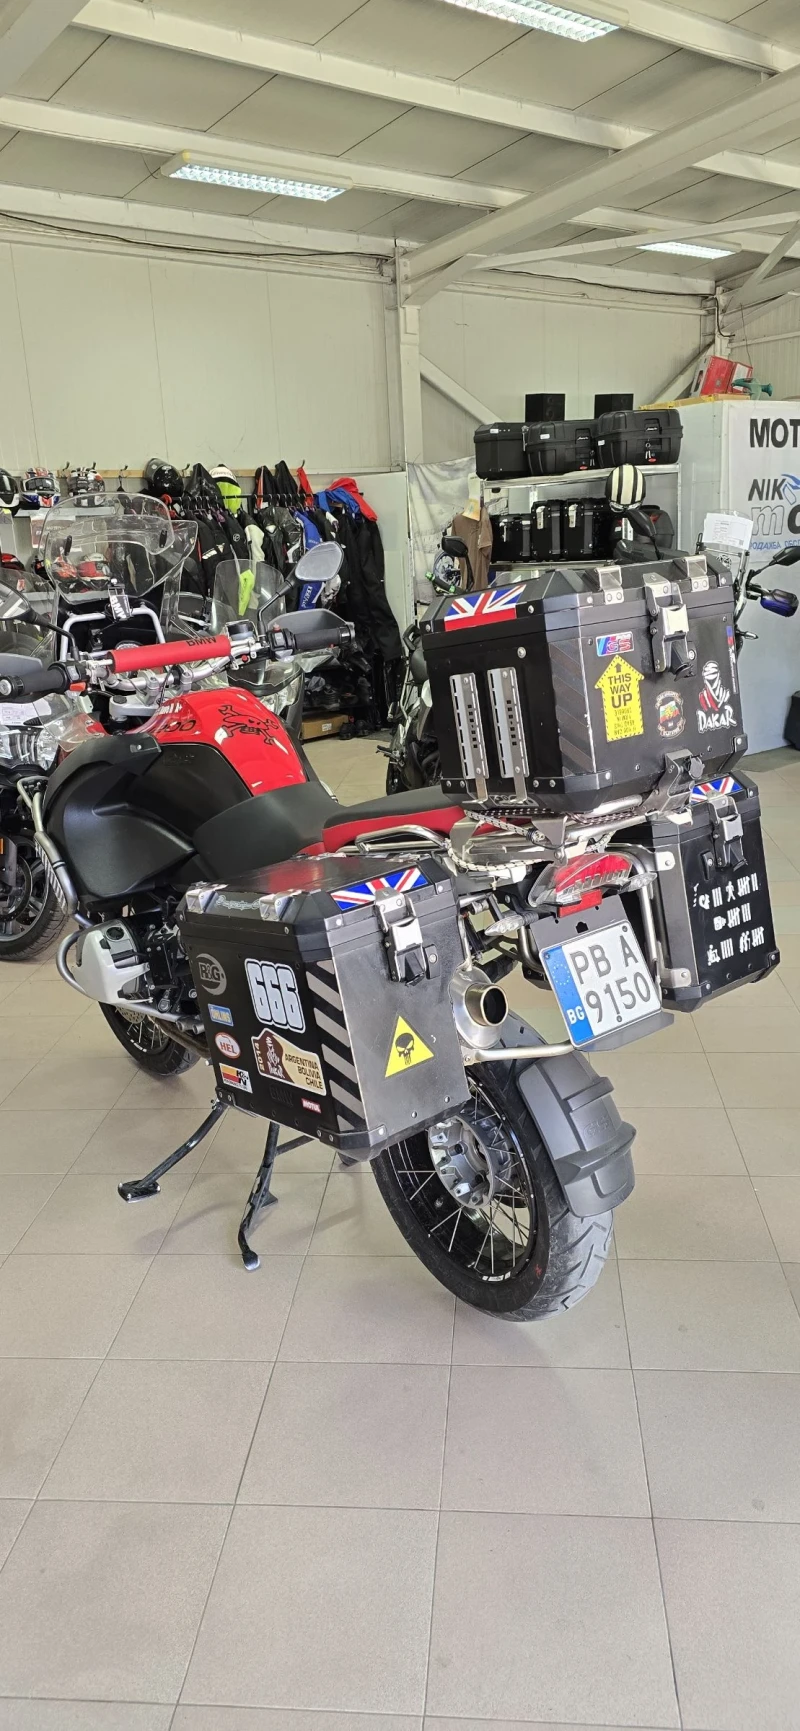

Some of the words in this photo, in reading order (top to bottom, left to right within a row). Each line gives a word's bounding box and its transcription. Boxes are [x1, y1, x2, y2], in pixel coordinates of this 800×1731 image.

[608, 673, 632, 686] THIS
[610, 683, 632, 695] WAY
[611, 693, 632, 709] UP
[697, 705, 737, 732] DAKAR
[569, 944, 611, 984] PB
[620, 935, 638, 967] A
[200, 963, 221, 980] R&G
[245, 959, 305, 1033] 666
[585, 971, 651, 1023] 9150
[566, 1005, 585, 1024] BG
[220, 1042, 237, 1055] HEL
[285, 1053, 319, 1070] ARGENTINA
[297, 1066, 321, 1080] BOLIVIA
[305, 1077, 323, 1090] CHILE
[302, 1100, 321, 1113] MOTUL
